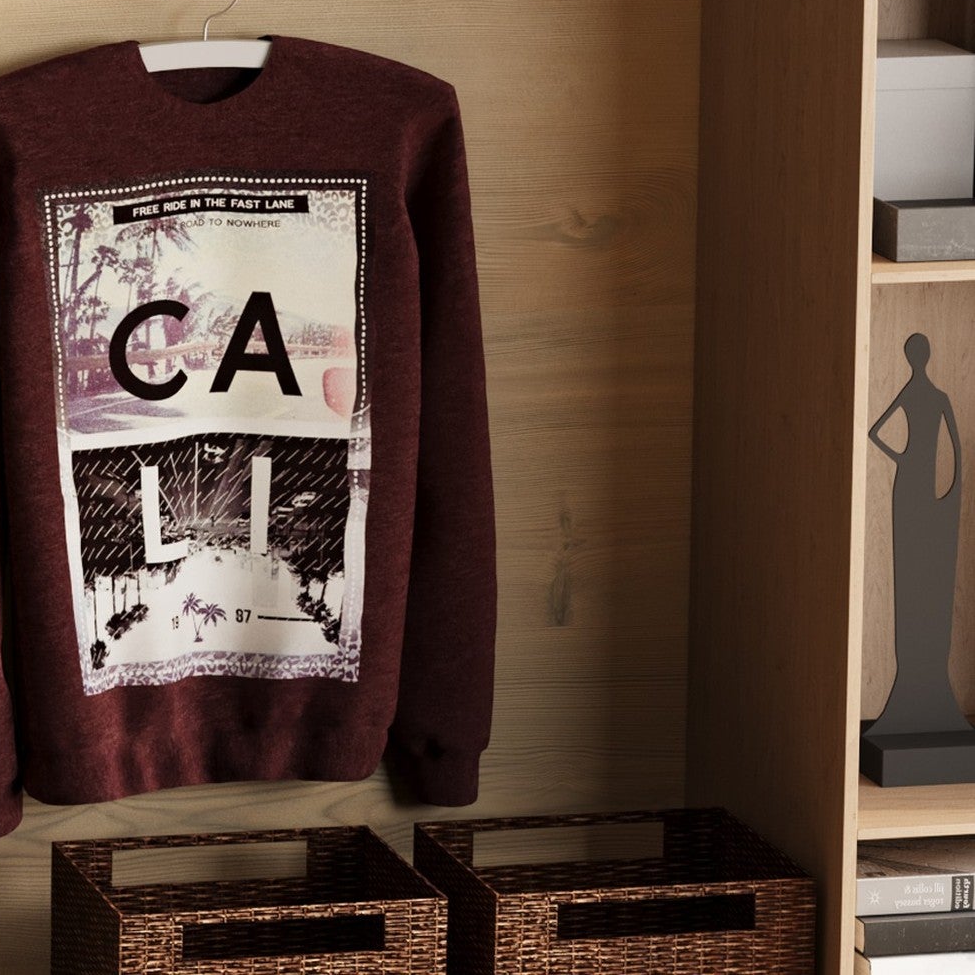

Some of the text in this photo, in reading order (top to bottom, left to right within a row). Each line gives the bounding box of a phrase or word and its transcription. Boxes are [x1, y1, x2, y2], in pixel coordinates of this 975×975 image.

[132, 197, 295, 218] FREE RIDE IN THE FAST LANE
[181, 218, 205, 229] ROAD
[209, 218, 223, 227] TO
[227, 219, 281, 229] NOWHERE
[235, 609, 251, 623] 87
